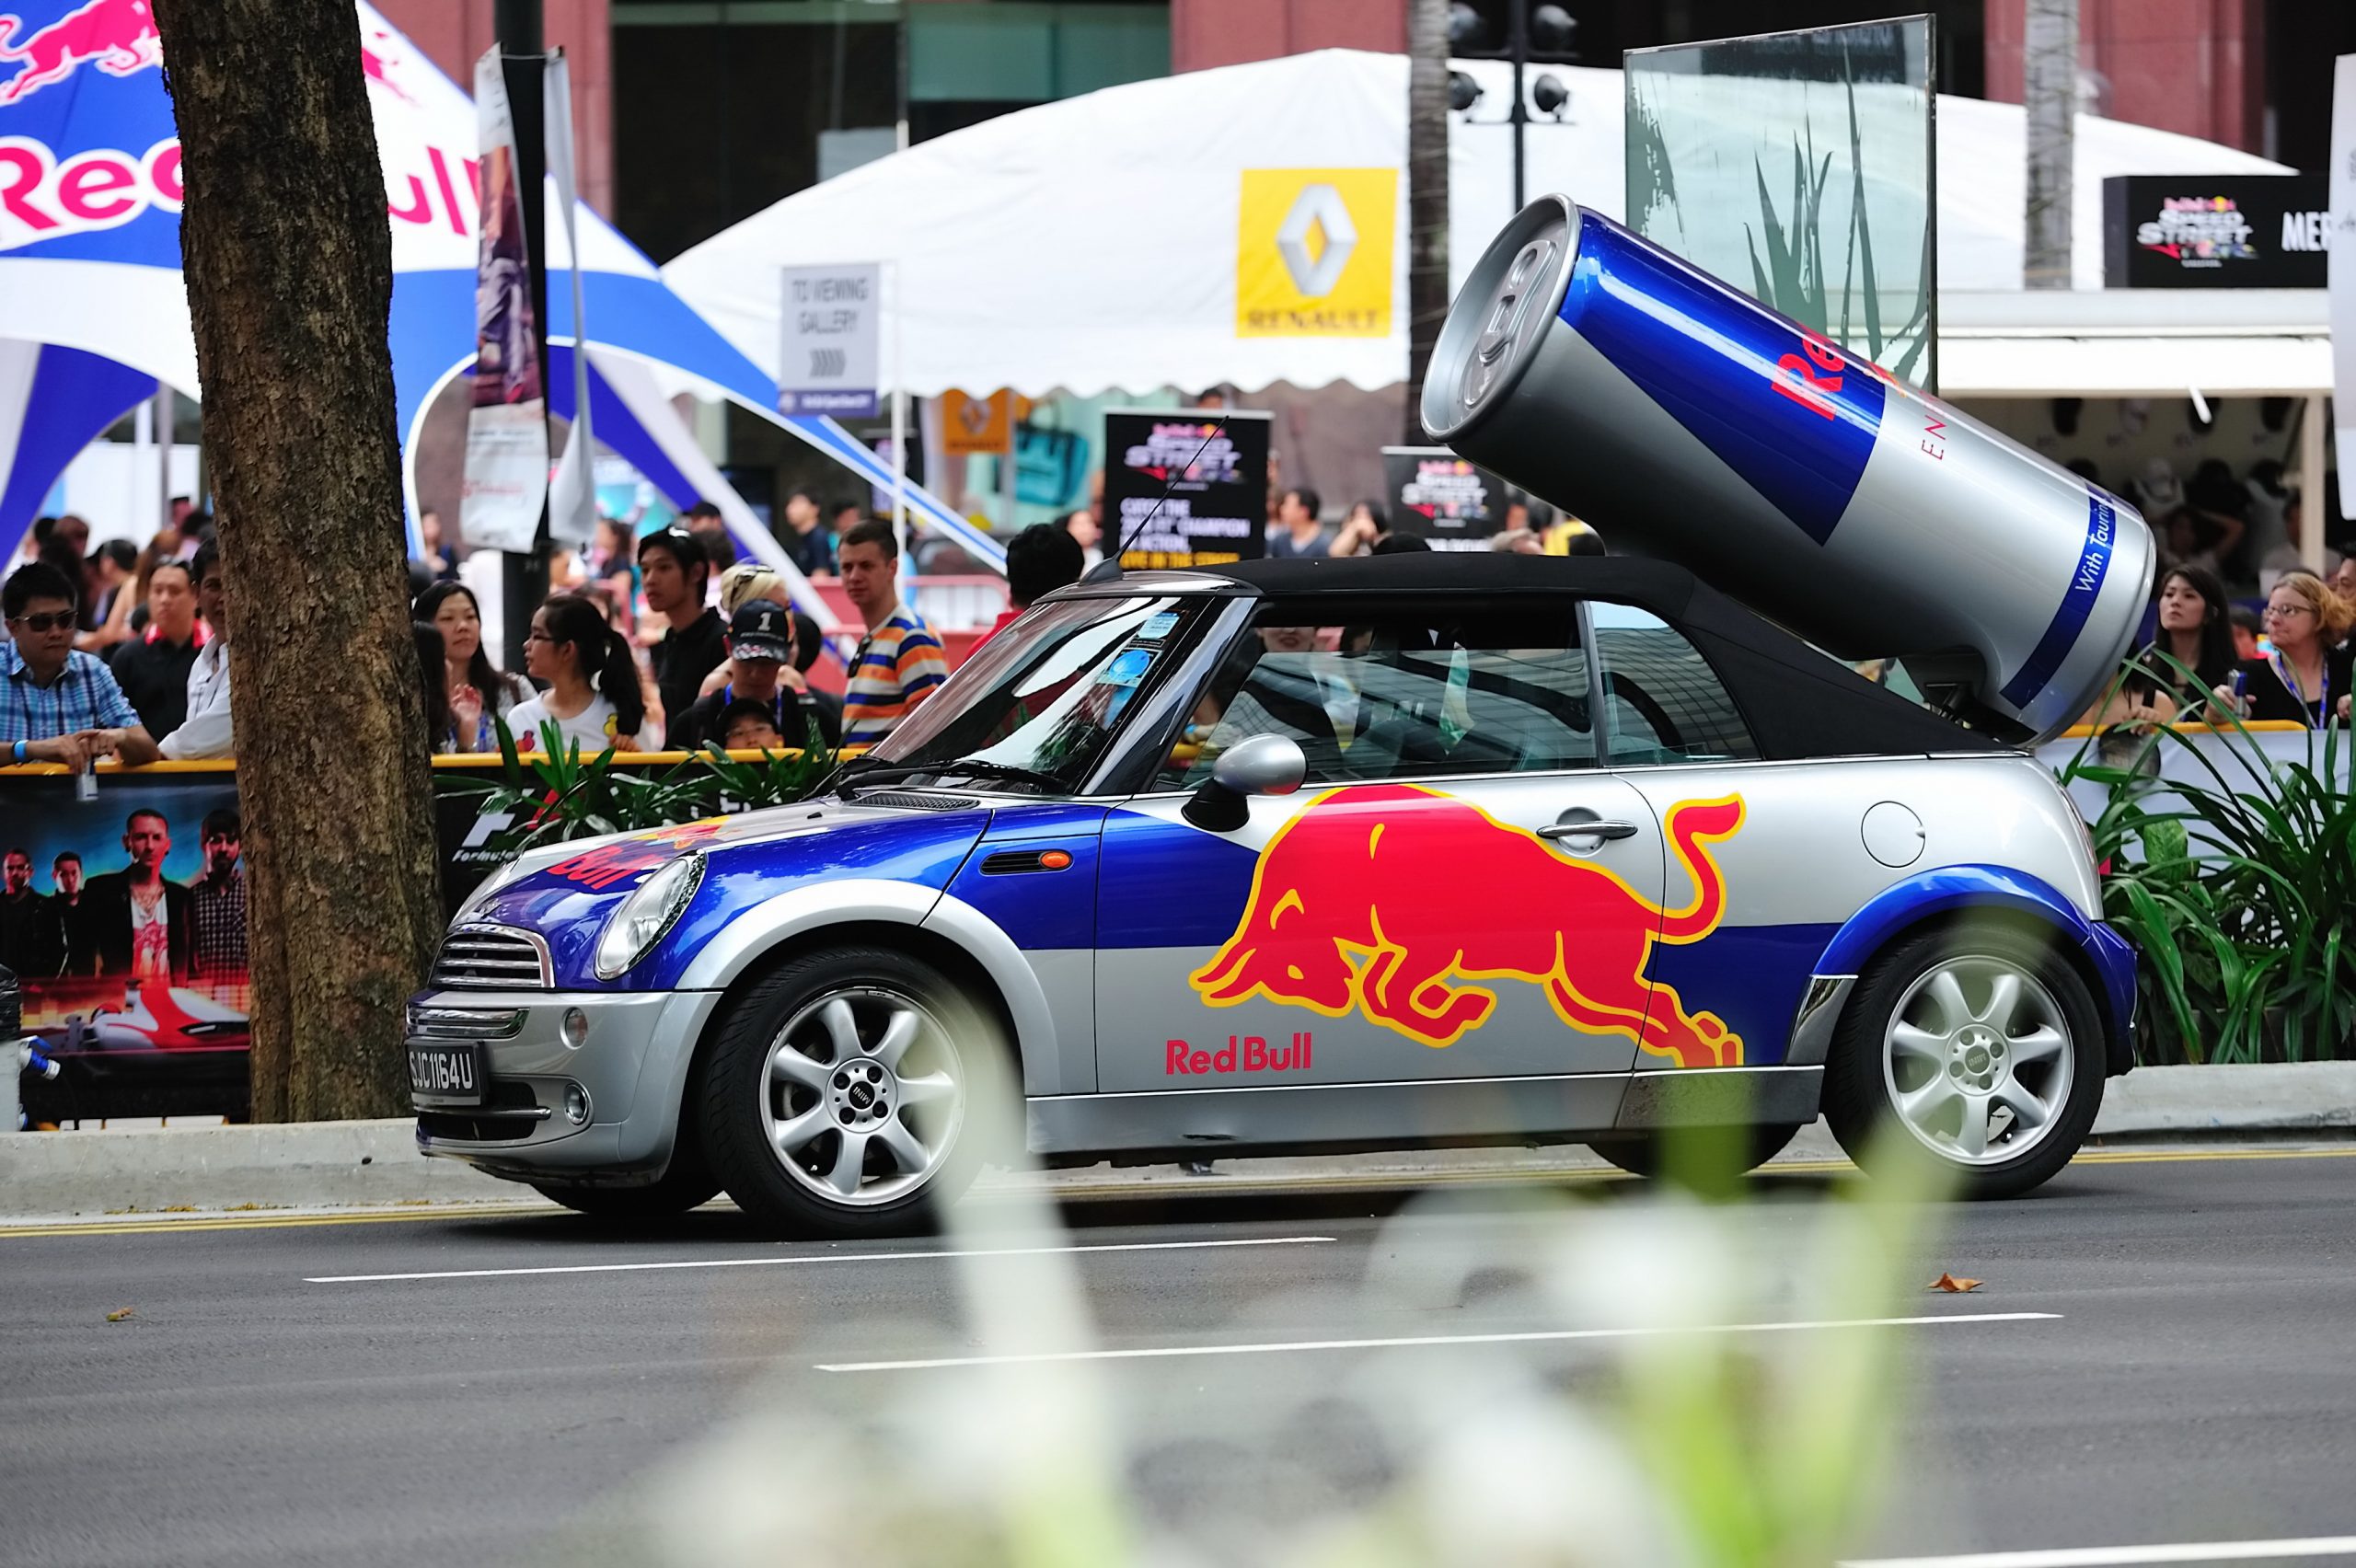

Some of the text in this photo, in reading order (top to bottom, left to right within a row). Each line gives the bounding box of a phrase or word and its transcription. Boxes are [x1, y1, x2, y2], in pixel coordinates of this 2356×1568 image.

[2137, 223, 2253, 245] STREET
[1771, 324, 1845, 421] Re
[2075, 501, 2109, 592] With Taurin
[758, 612, 772, 631] 1
[547, 845, 664, 890] Bull
[410, 1052, 473, 1090] SJC1164U
[1166, 1032, 1311, 1075] Red Bull
[852, 1086, 872, 1104] MINI
